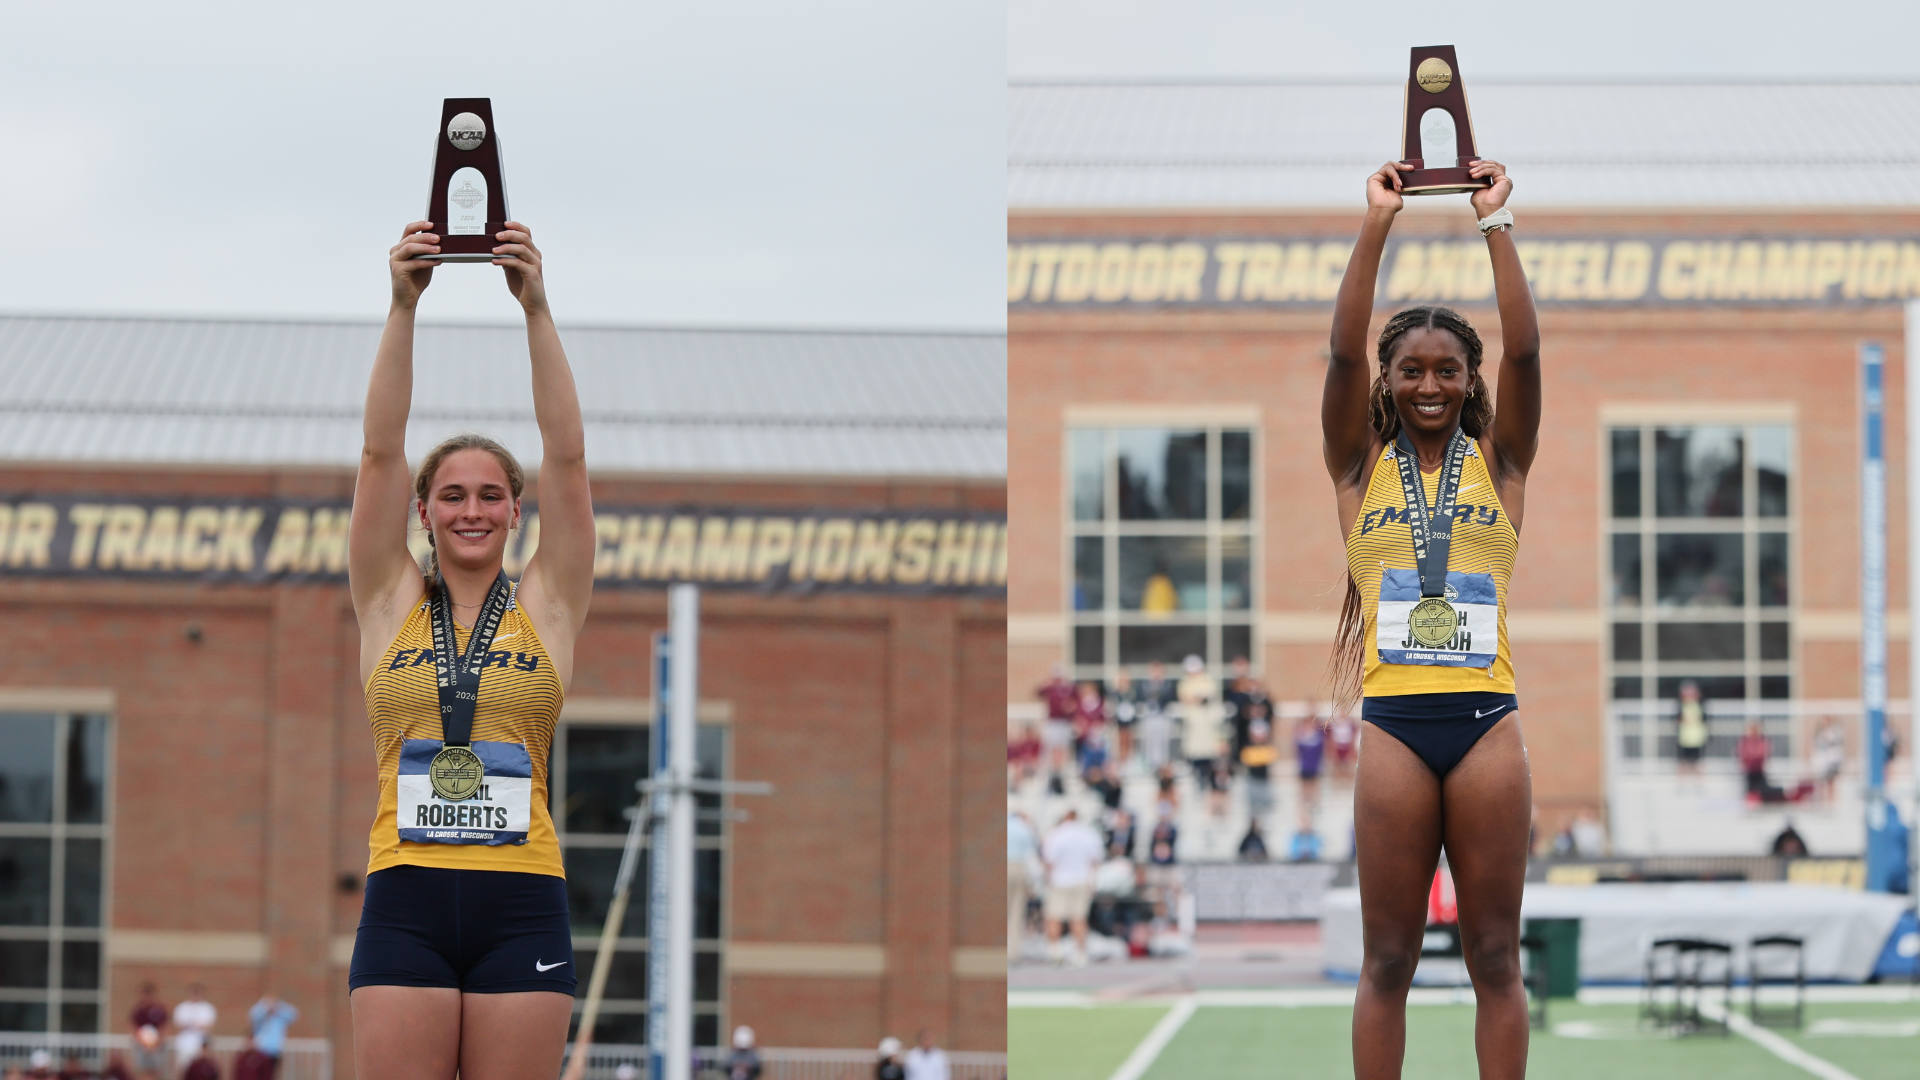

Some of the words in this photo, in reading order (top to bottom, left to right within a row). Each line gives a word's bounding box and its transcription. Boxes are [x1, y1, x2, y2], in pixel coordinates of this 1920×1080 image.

[1420, 74, 1450, 84] NCAA
[450, 131, 484, 140] NCAA
[1213, 242, 1388, 302] TRAC
[1385, 241, 1496, 302] AND
[1398, 456, 1426, 559] ALL-AMERICAN
[1361, 505, 1498, 537] EMRY
[68, 504, 266, 571] TRACK
[264, 507, 350, 575] AN
[1432, 532, 1451, 540] 2026
[470, 586, 508, 675] ALL-AMERICAN
[388, 649, 538, 672] EMRY
[449, 669, 457, 685] FIELD
[455, 691, 476, 701] 2026
[416, 804, 507, 829] ROBERTS
[461, 832, 494, 840] WISCONSIN
